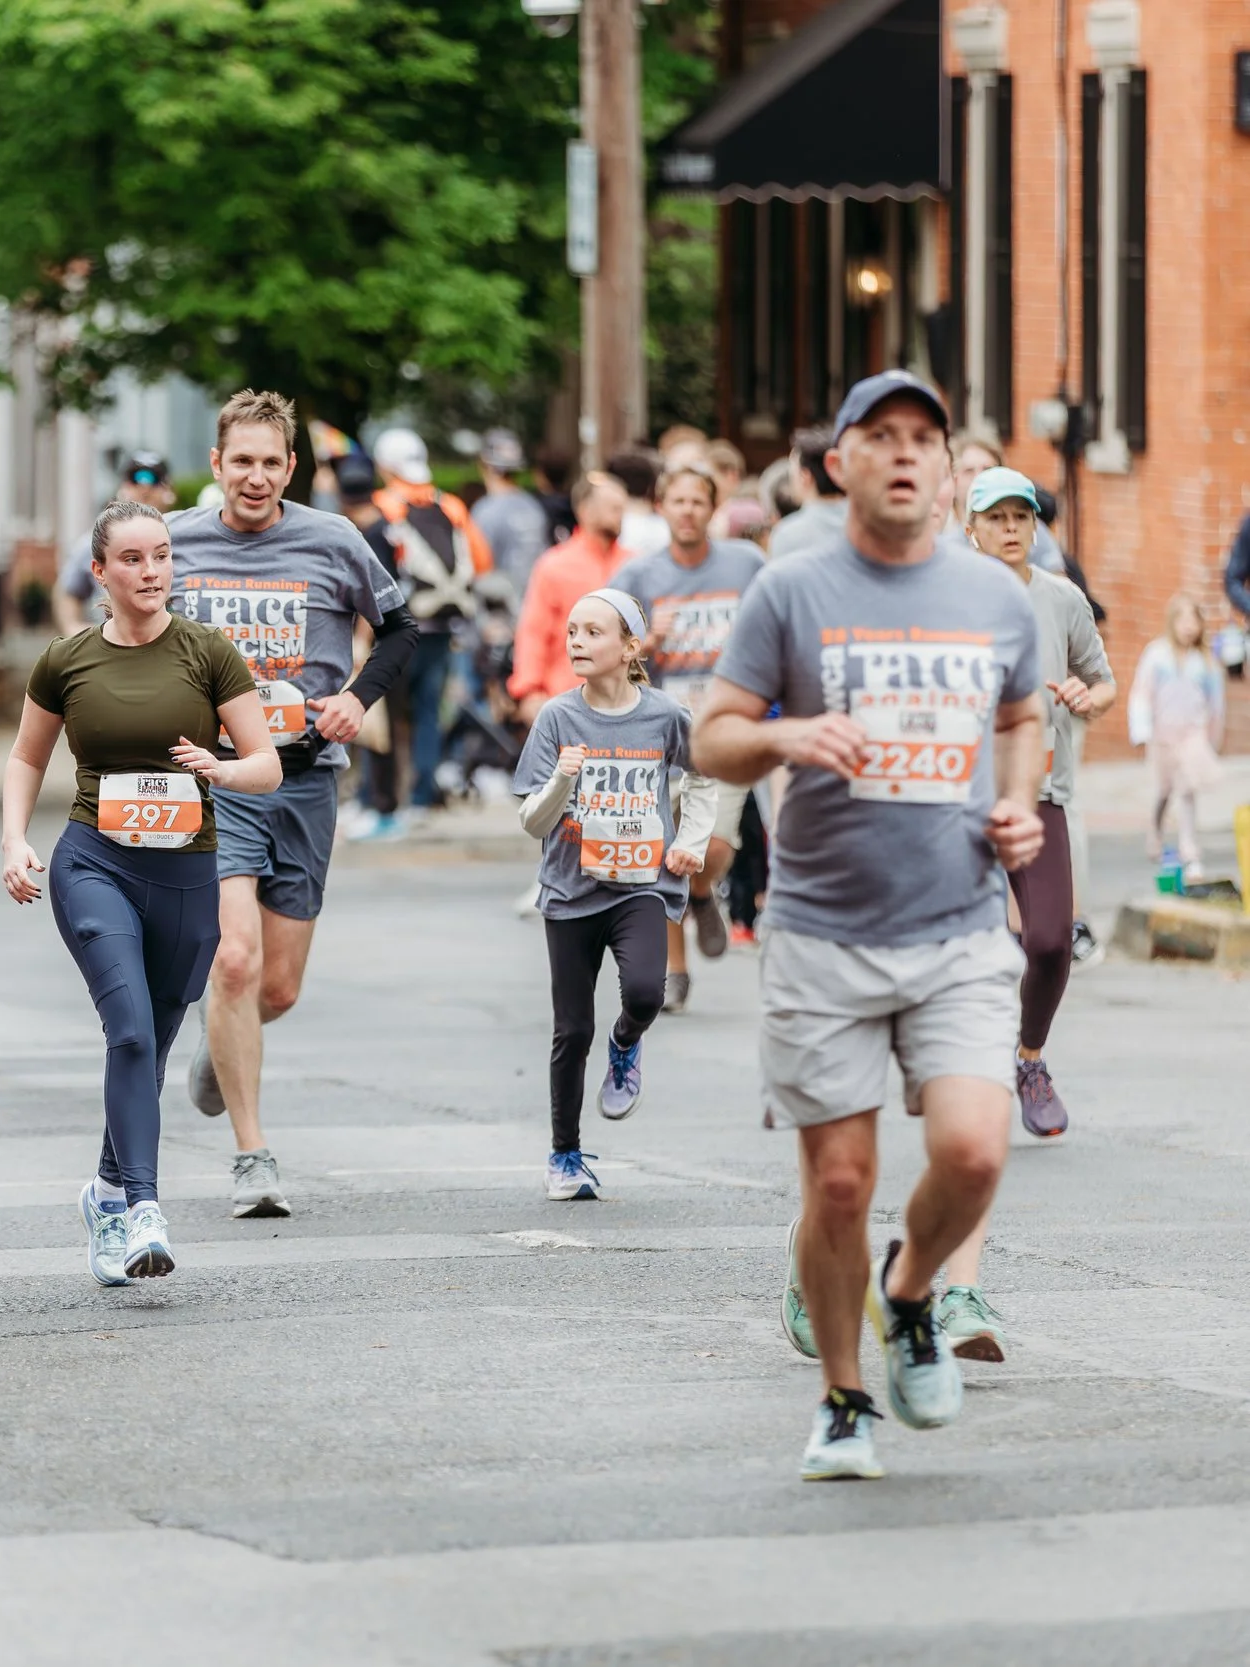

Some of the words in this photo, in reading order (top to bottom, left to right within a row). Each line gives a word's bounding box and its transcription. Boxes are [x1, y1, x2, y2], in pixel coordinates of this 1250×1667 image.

[184, 577, 201, 589] 28
[205, 577, 241, 589] Years
[245, 578, 310, 592] Running!
[200, 594, 307, 626] race
[222, 624, 302, 641] gainst
[232, 640, 306, 659] CISM
[268, 708, 287, 730] 4
[861, 745, 967, 779] 2240
[121, 804, 181, 829] 297
[599, 844, 652, 867] 250
